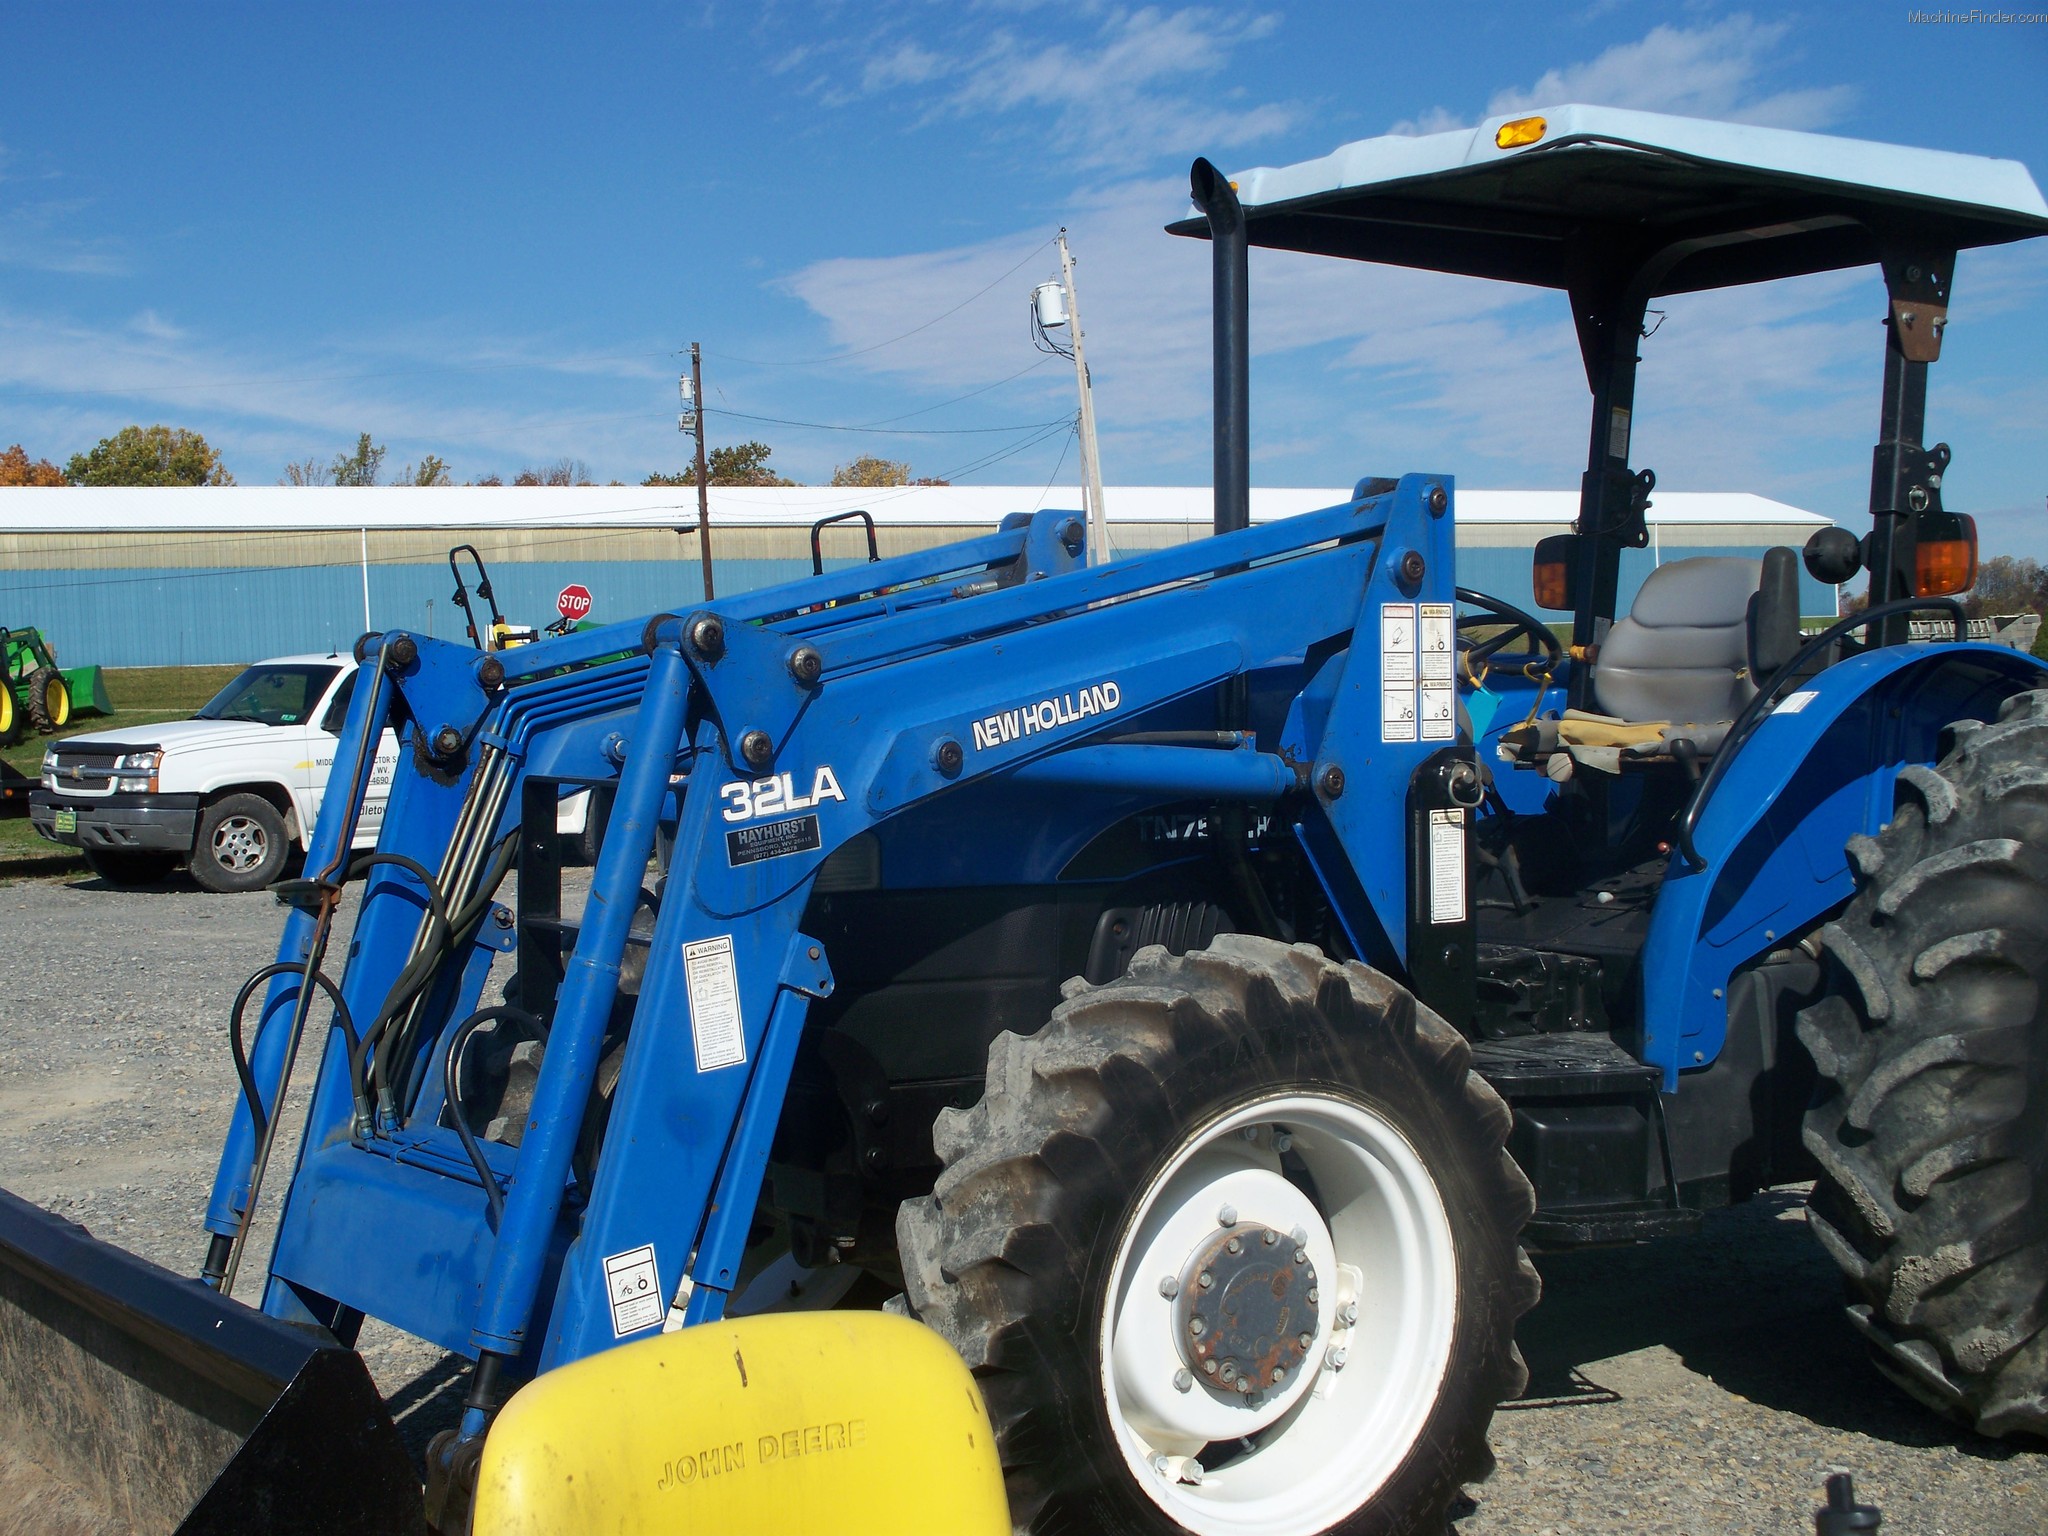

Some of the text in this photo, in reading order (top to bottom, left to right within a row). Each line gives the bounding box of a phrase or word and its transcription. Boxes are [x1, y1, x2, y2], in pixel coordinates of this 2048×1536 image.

[560, 594, 590, 611] STOP
[972, 681, 1121, 751] NEW HOLLAND
[316, 758, 334, 766] MIDD
[721, 765, 847, 822] 32LA
[738, 819, 807, 845] HAYHURST
[697, 942, 728, 954] WARNING
[657, 1418, 867, 1491] JOHN DEERE
